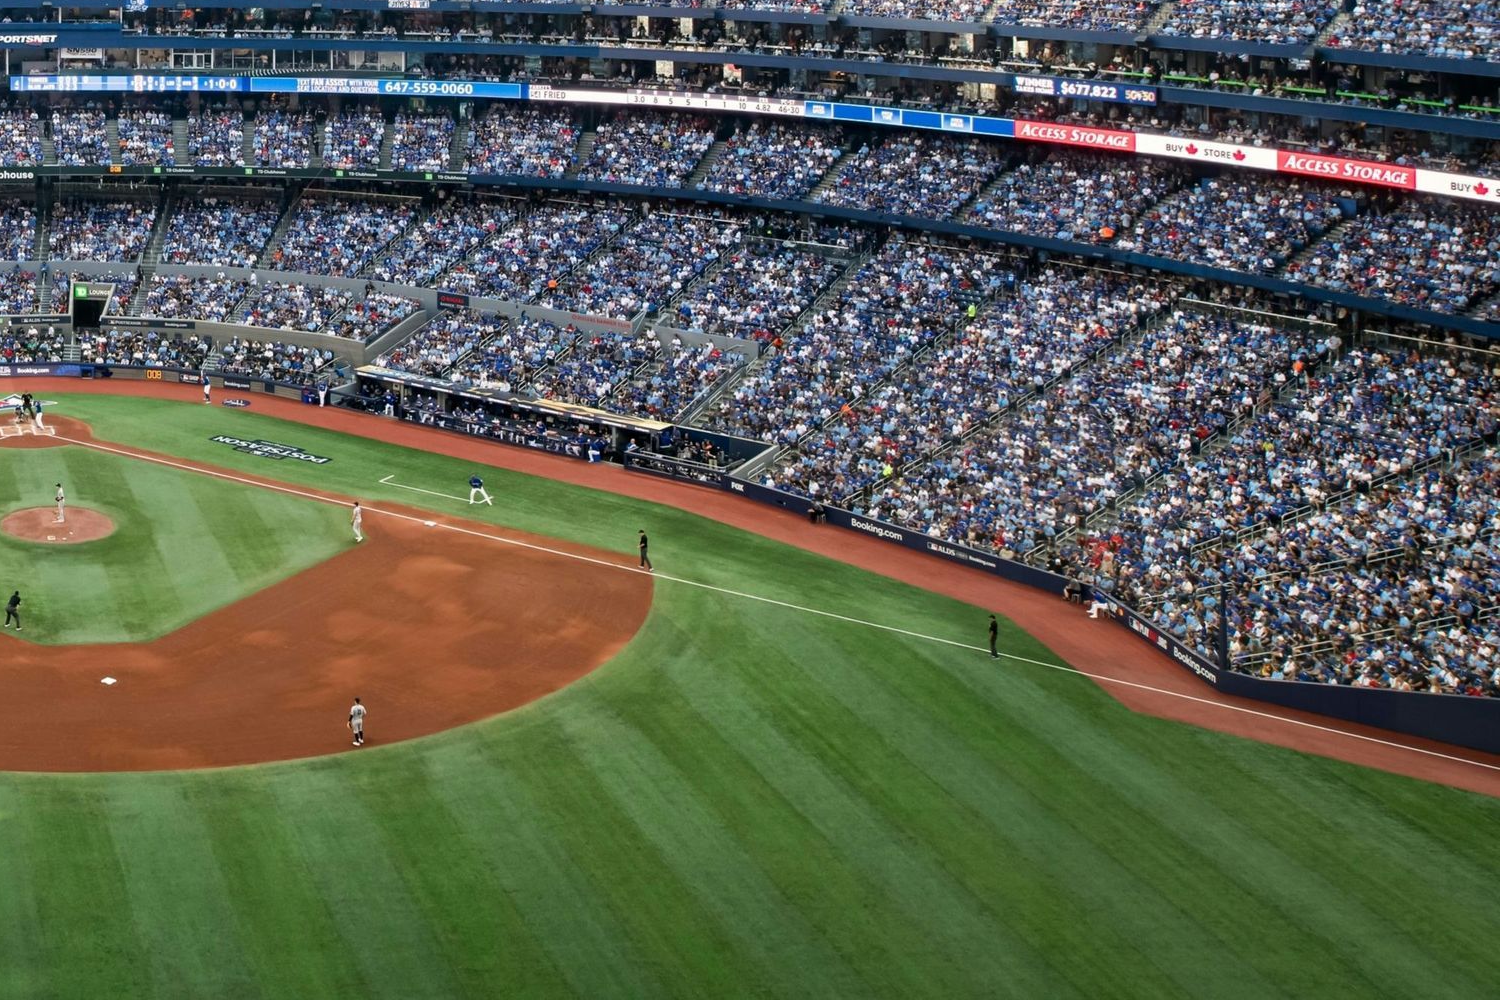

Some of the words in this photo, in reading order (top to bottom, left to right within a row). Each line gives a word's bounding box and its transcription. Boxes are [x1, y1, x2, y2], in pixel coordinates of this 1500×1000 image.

[325, 79, 348, 87] ASSIST
[384, 81, 473, 95] 647-559-0060
[1015, 76, 1054, 88] WINNER
[1060, 81, 1117, 98] $677,822
[543, 90, 566, 99] FRIED
[755, 104, 771, 112] 4.82
[778, 106, 800, 114] 46-30
[1020, 123, 1067, 140] ACCESS
[1070, 128, 1129, 148] STORAGE
[1165, 143, 1184, 153] BUY
[1203, 148, 1231, 159] STORE
[1283, 154, 1339, 175] ACCESS
[1342, 162, 1409, 185] STORAGE
[1450, 182, 1471, 193] BUY
[212, 436, 329, 464] POSTSEASON
[731, 482, 745, 492] FOX
[851, 518, 903, 542] Booking.com
[938, 545, 956, 556] ALDS
[1173, 646, 1217, 684] Booking.com
